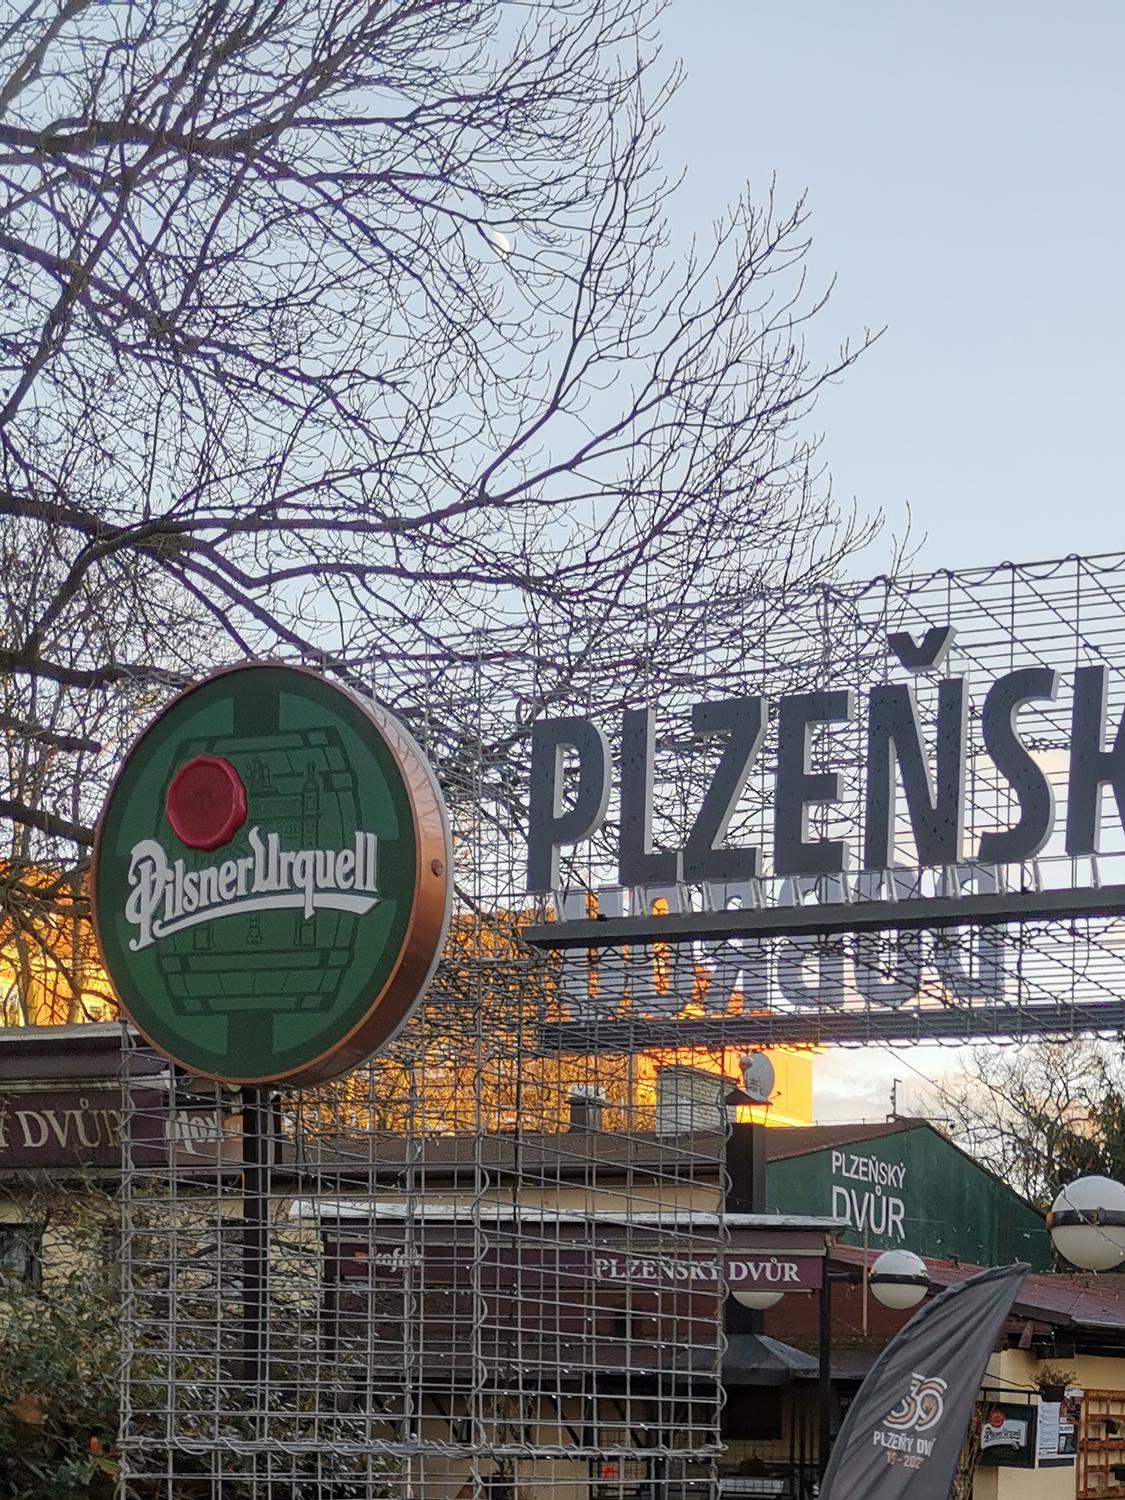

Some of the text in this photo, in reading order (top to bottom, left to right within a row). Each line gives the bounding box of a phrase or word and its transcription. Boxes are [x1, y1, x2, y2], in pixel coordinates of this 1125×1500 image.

[125, 826, 379, 951] Pilsner Urquell
[831, 1150, 907, 1189] PLZEŇSKÝ
[832, 1184, 906, 1240] DVŮR
[728, 1256, 801, 1282] DVŮR
